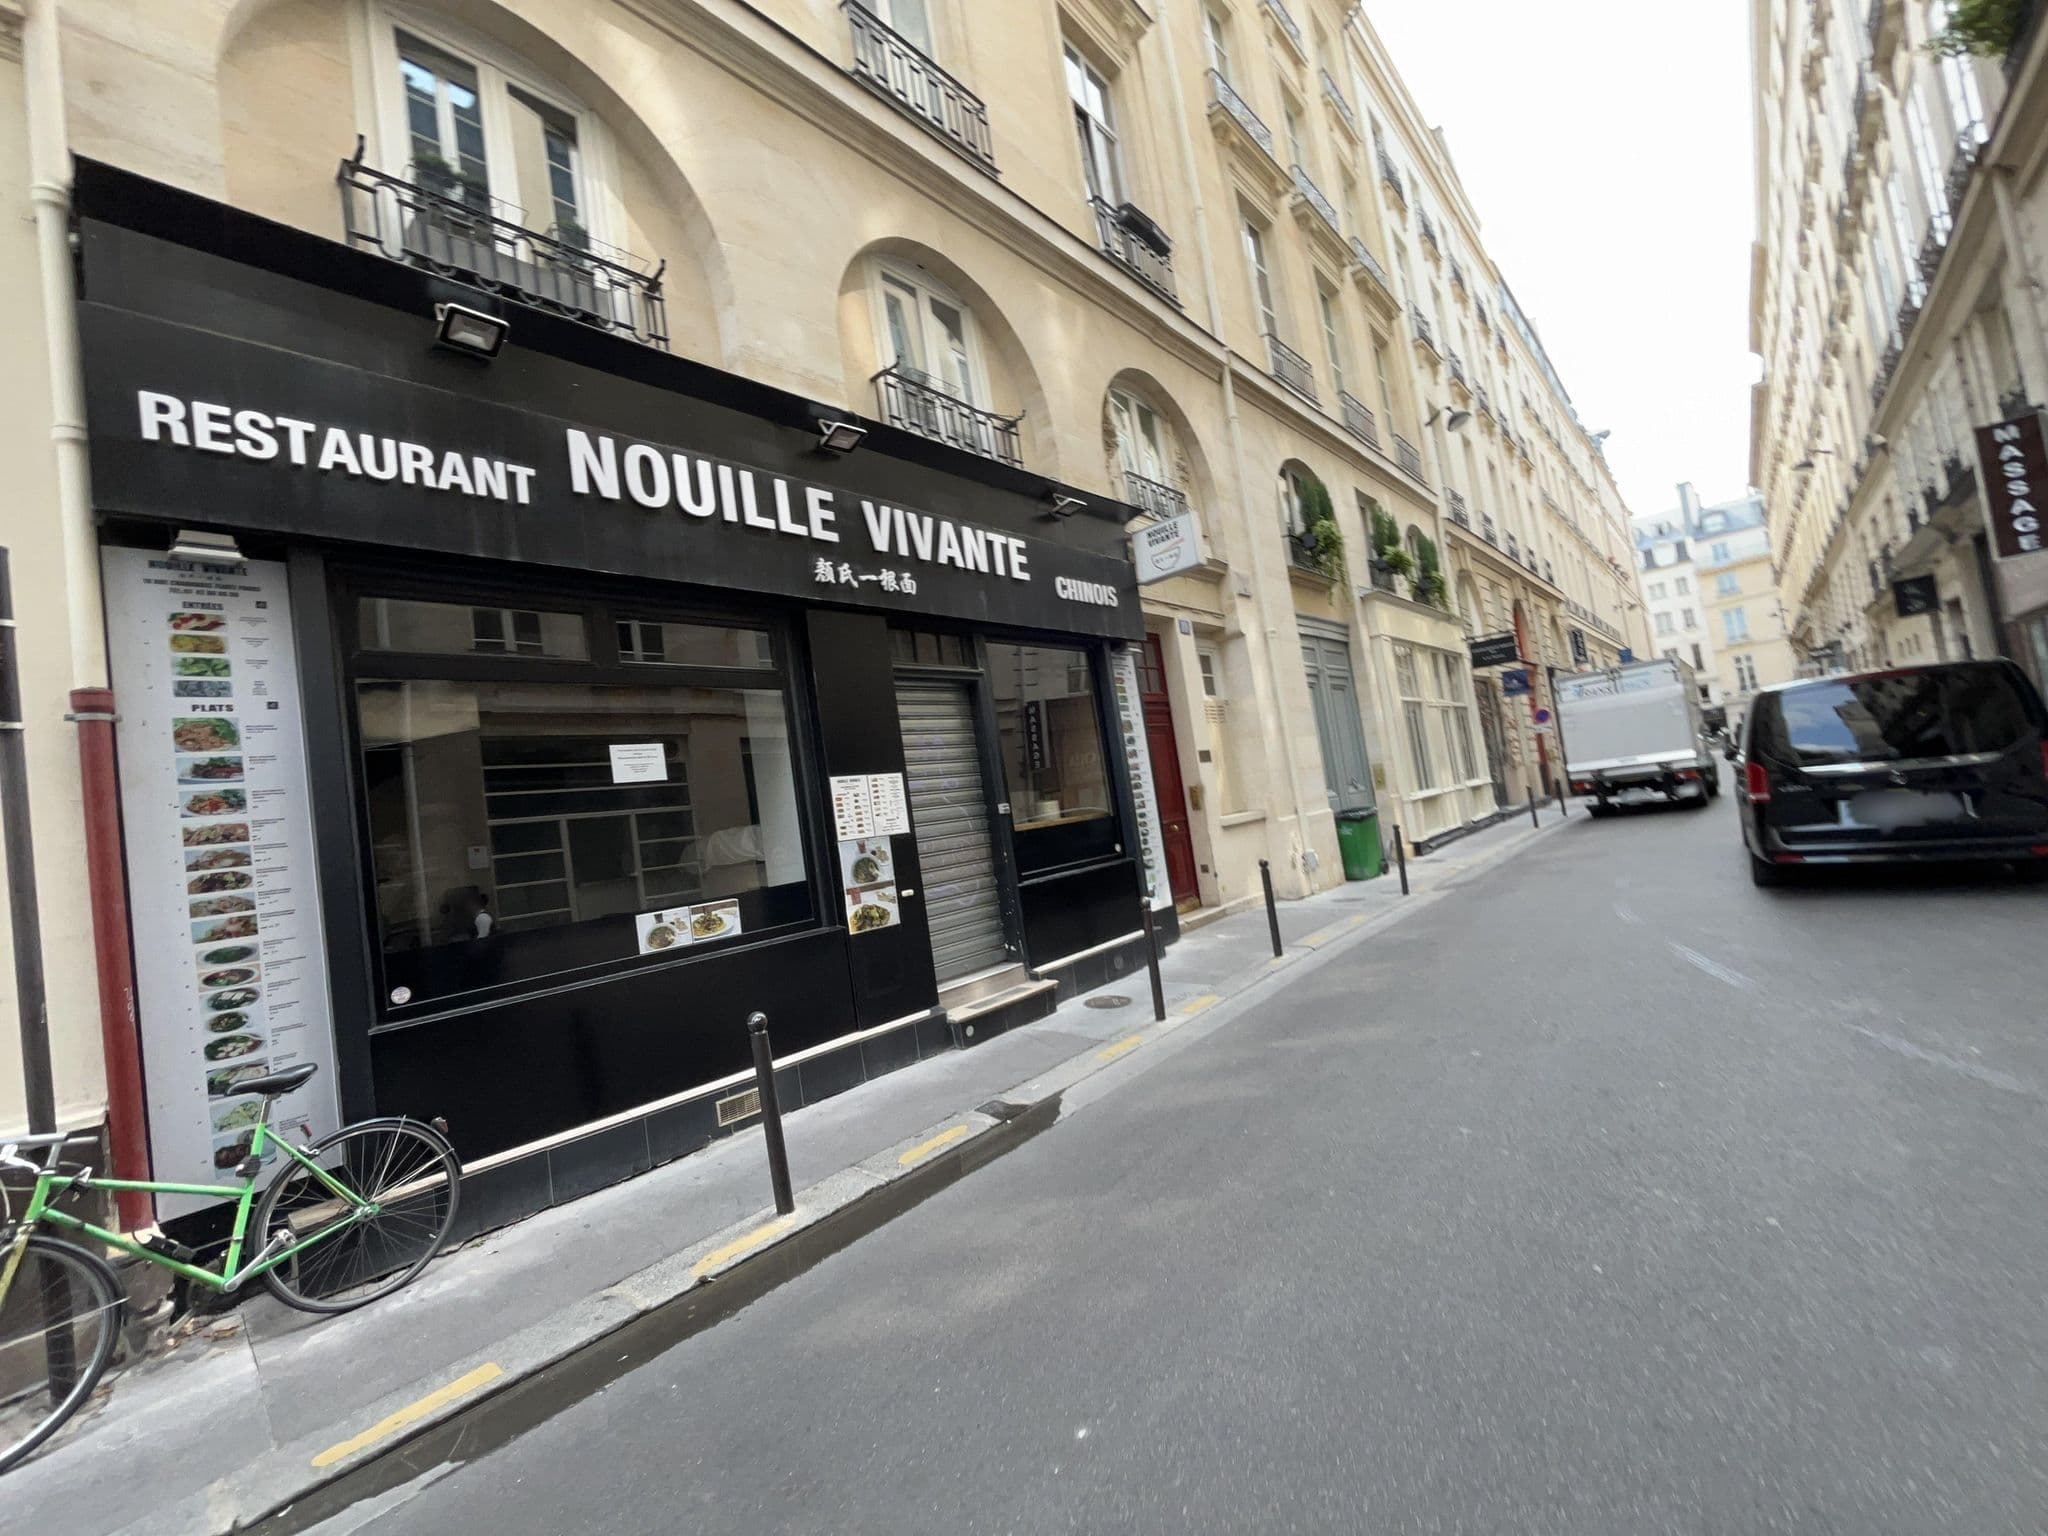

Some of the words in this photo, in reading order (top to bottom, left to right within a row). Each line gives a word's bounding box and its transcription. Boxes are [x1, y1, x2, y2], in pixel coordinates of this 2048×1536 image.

[137, 389, 536, 504] RESTAURANT
[565, 427, 839, 544] NOUILLE
[859, 498, 1031, 581] VIVANTE
[1992, 423, 2042, 551] MASSAGE
[1054, 575, 1119, 608] CHINOIS
[191, 704, 234, 713] PLATS
